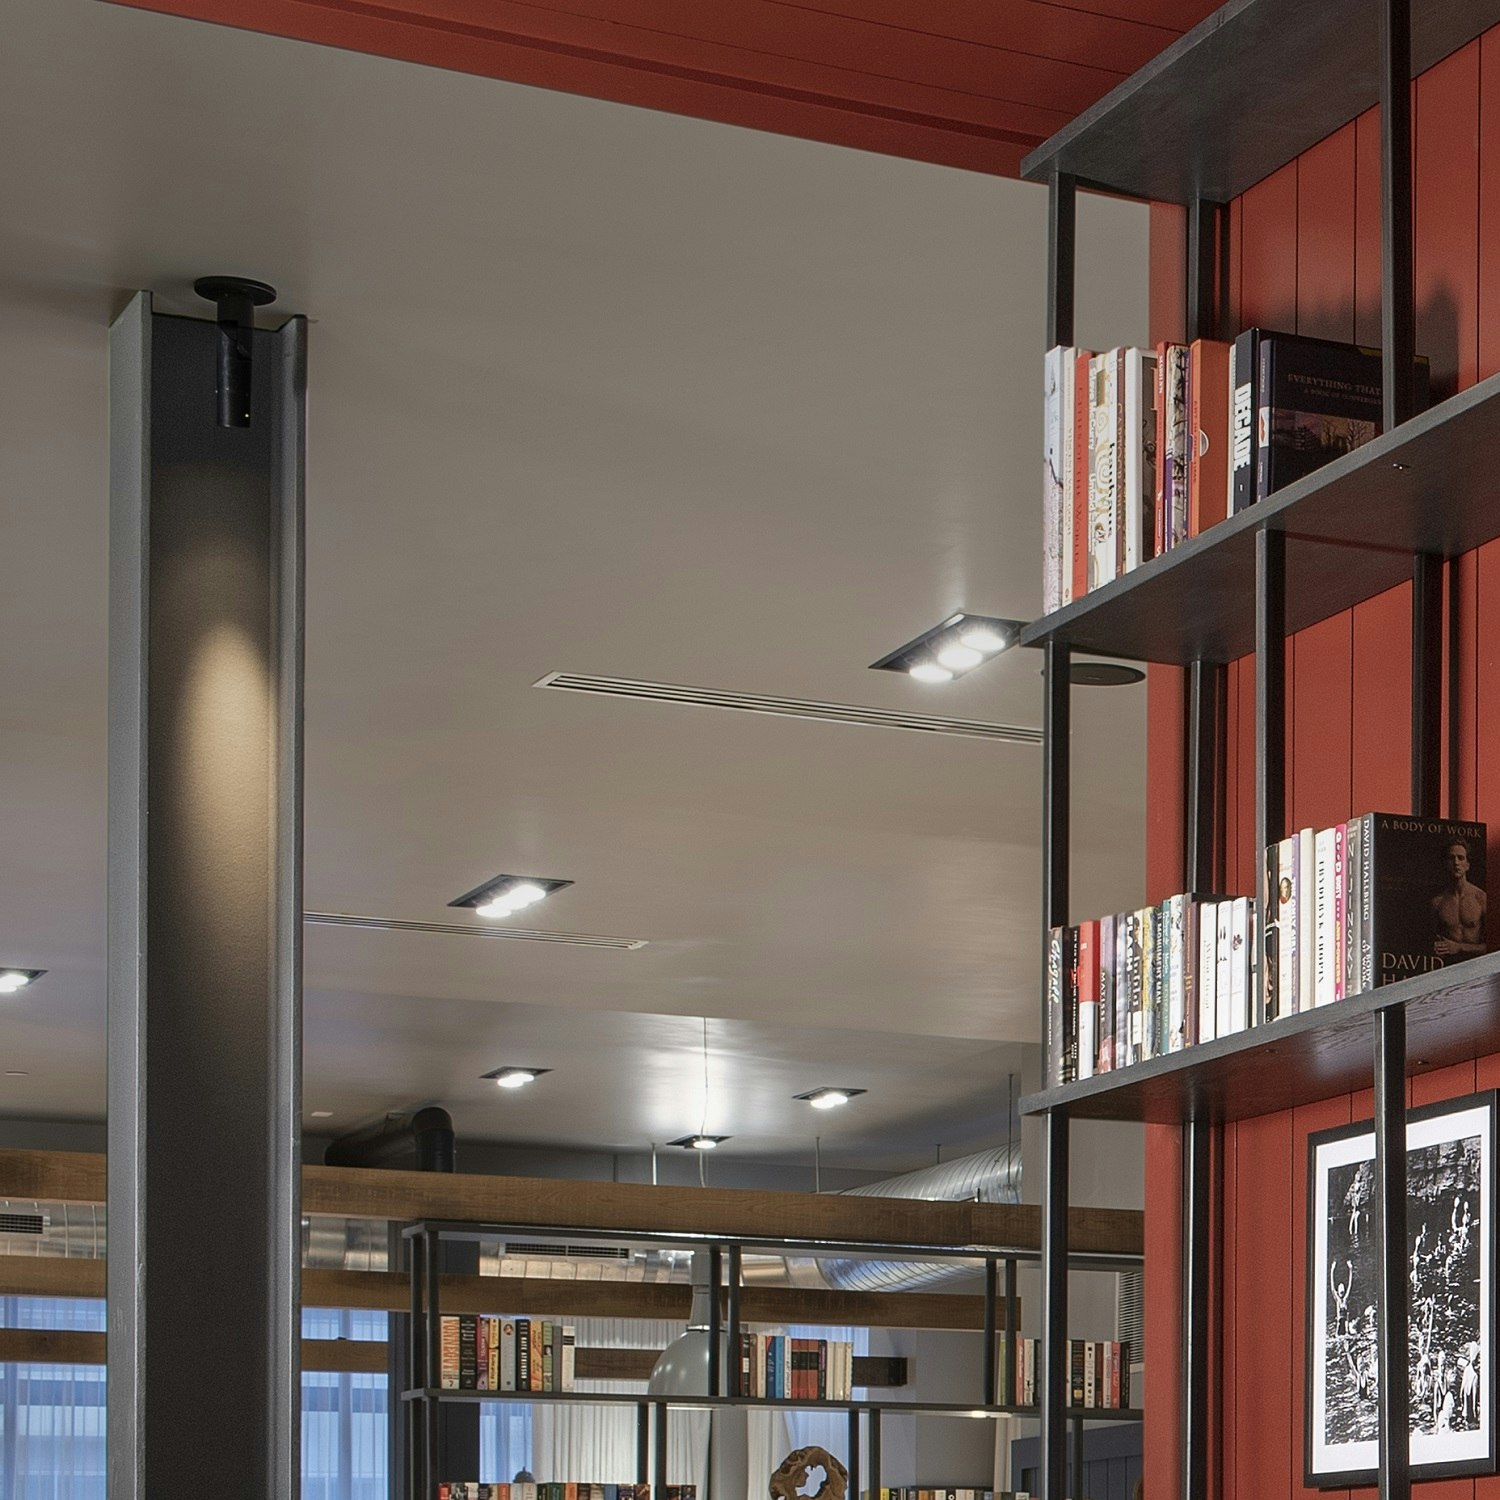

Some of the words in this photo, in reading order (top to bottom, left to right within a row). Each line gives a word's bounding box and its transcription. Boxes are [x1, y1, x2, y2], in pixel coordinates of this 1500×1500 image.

[1287, 373, 1352, 390] EVERYTHING
[1355, 383, 1382, 396] THAT
[1233, 382, 1251, 472] DECADE
[1381, 819, 1389, 829] A
[1393, 820, 1425, 833] BODY
[1427, 823, 1441, 834] OF
[1447, 825, 1481, 839] WORK
[1346, 842, 1355, 980] NIJINSKY
[1050, 938, 1060, 1004] Chagall
[1126, 915, 1134, 972] FLASH
[1381, 951, 1445, 972] DAVID
